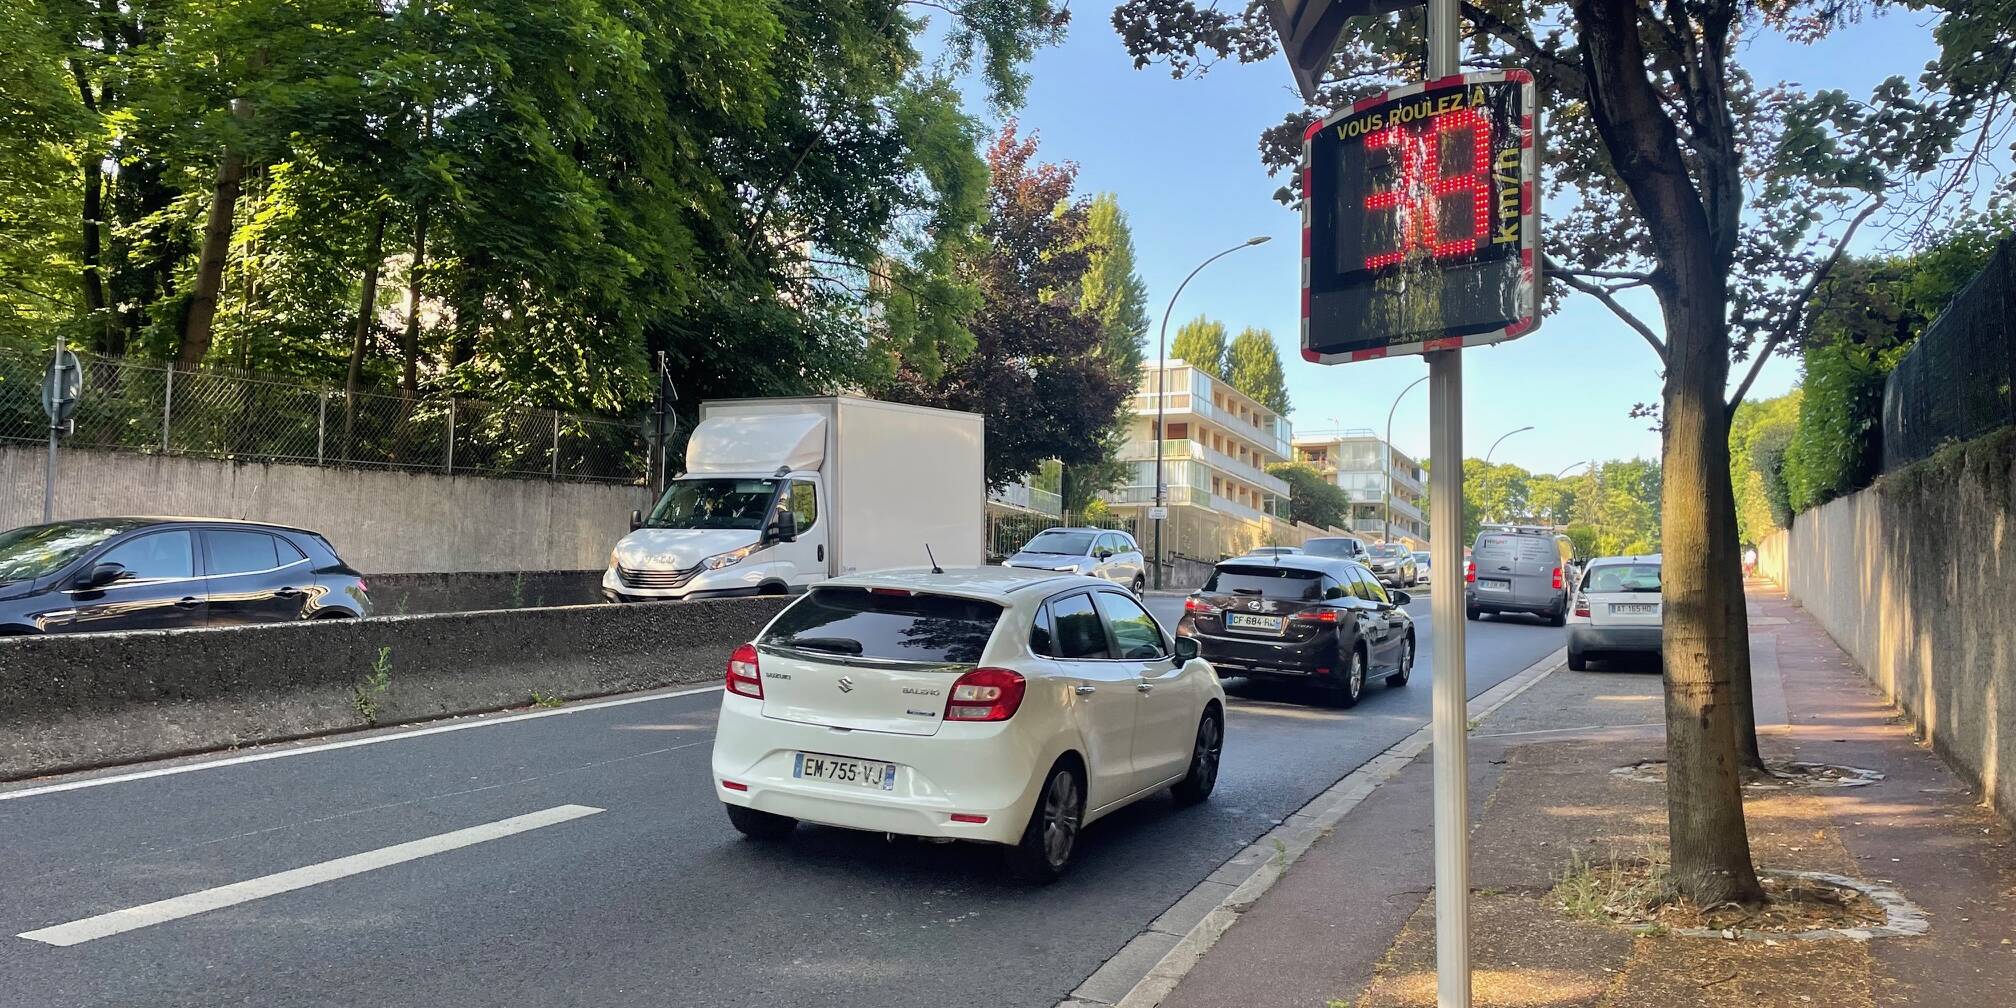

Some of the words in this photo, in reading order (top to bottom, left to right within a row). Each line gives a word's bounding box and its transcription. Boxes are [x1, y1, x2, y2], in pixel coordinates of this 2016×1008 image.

[1336, 113, 1383, 141] VOUS
[1389, 93, 1464, 127] ROULEZ
[1491, 147, 1519, 244] km/h
[902, 687, 941, 696] BALENO
